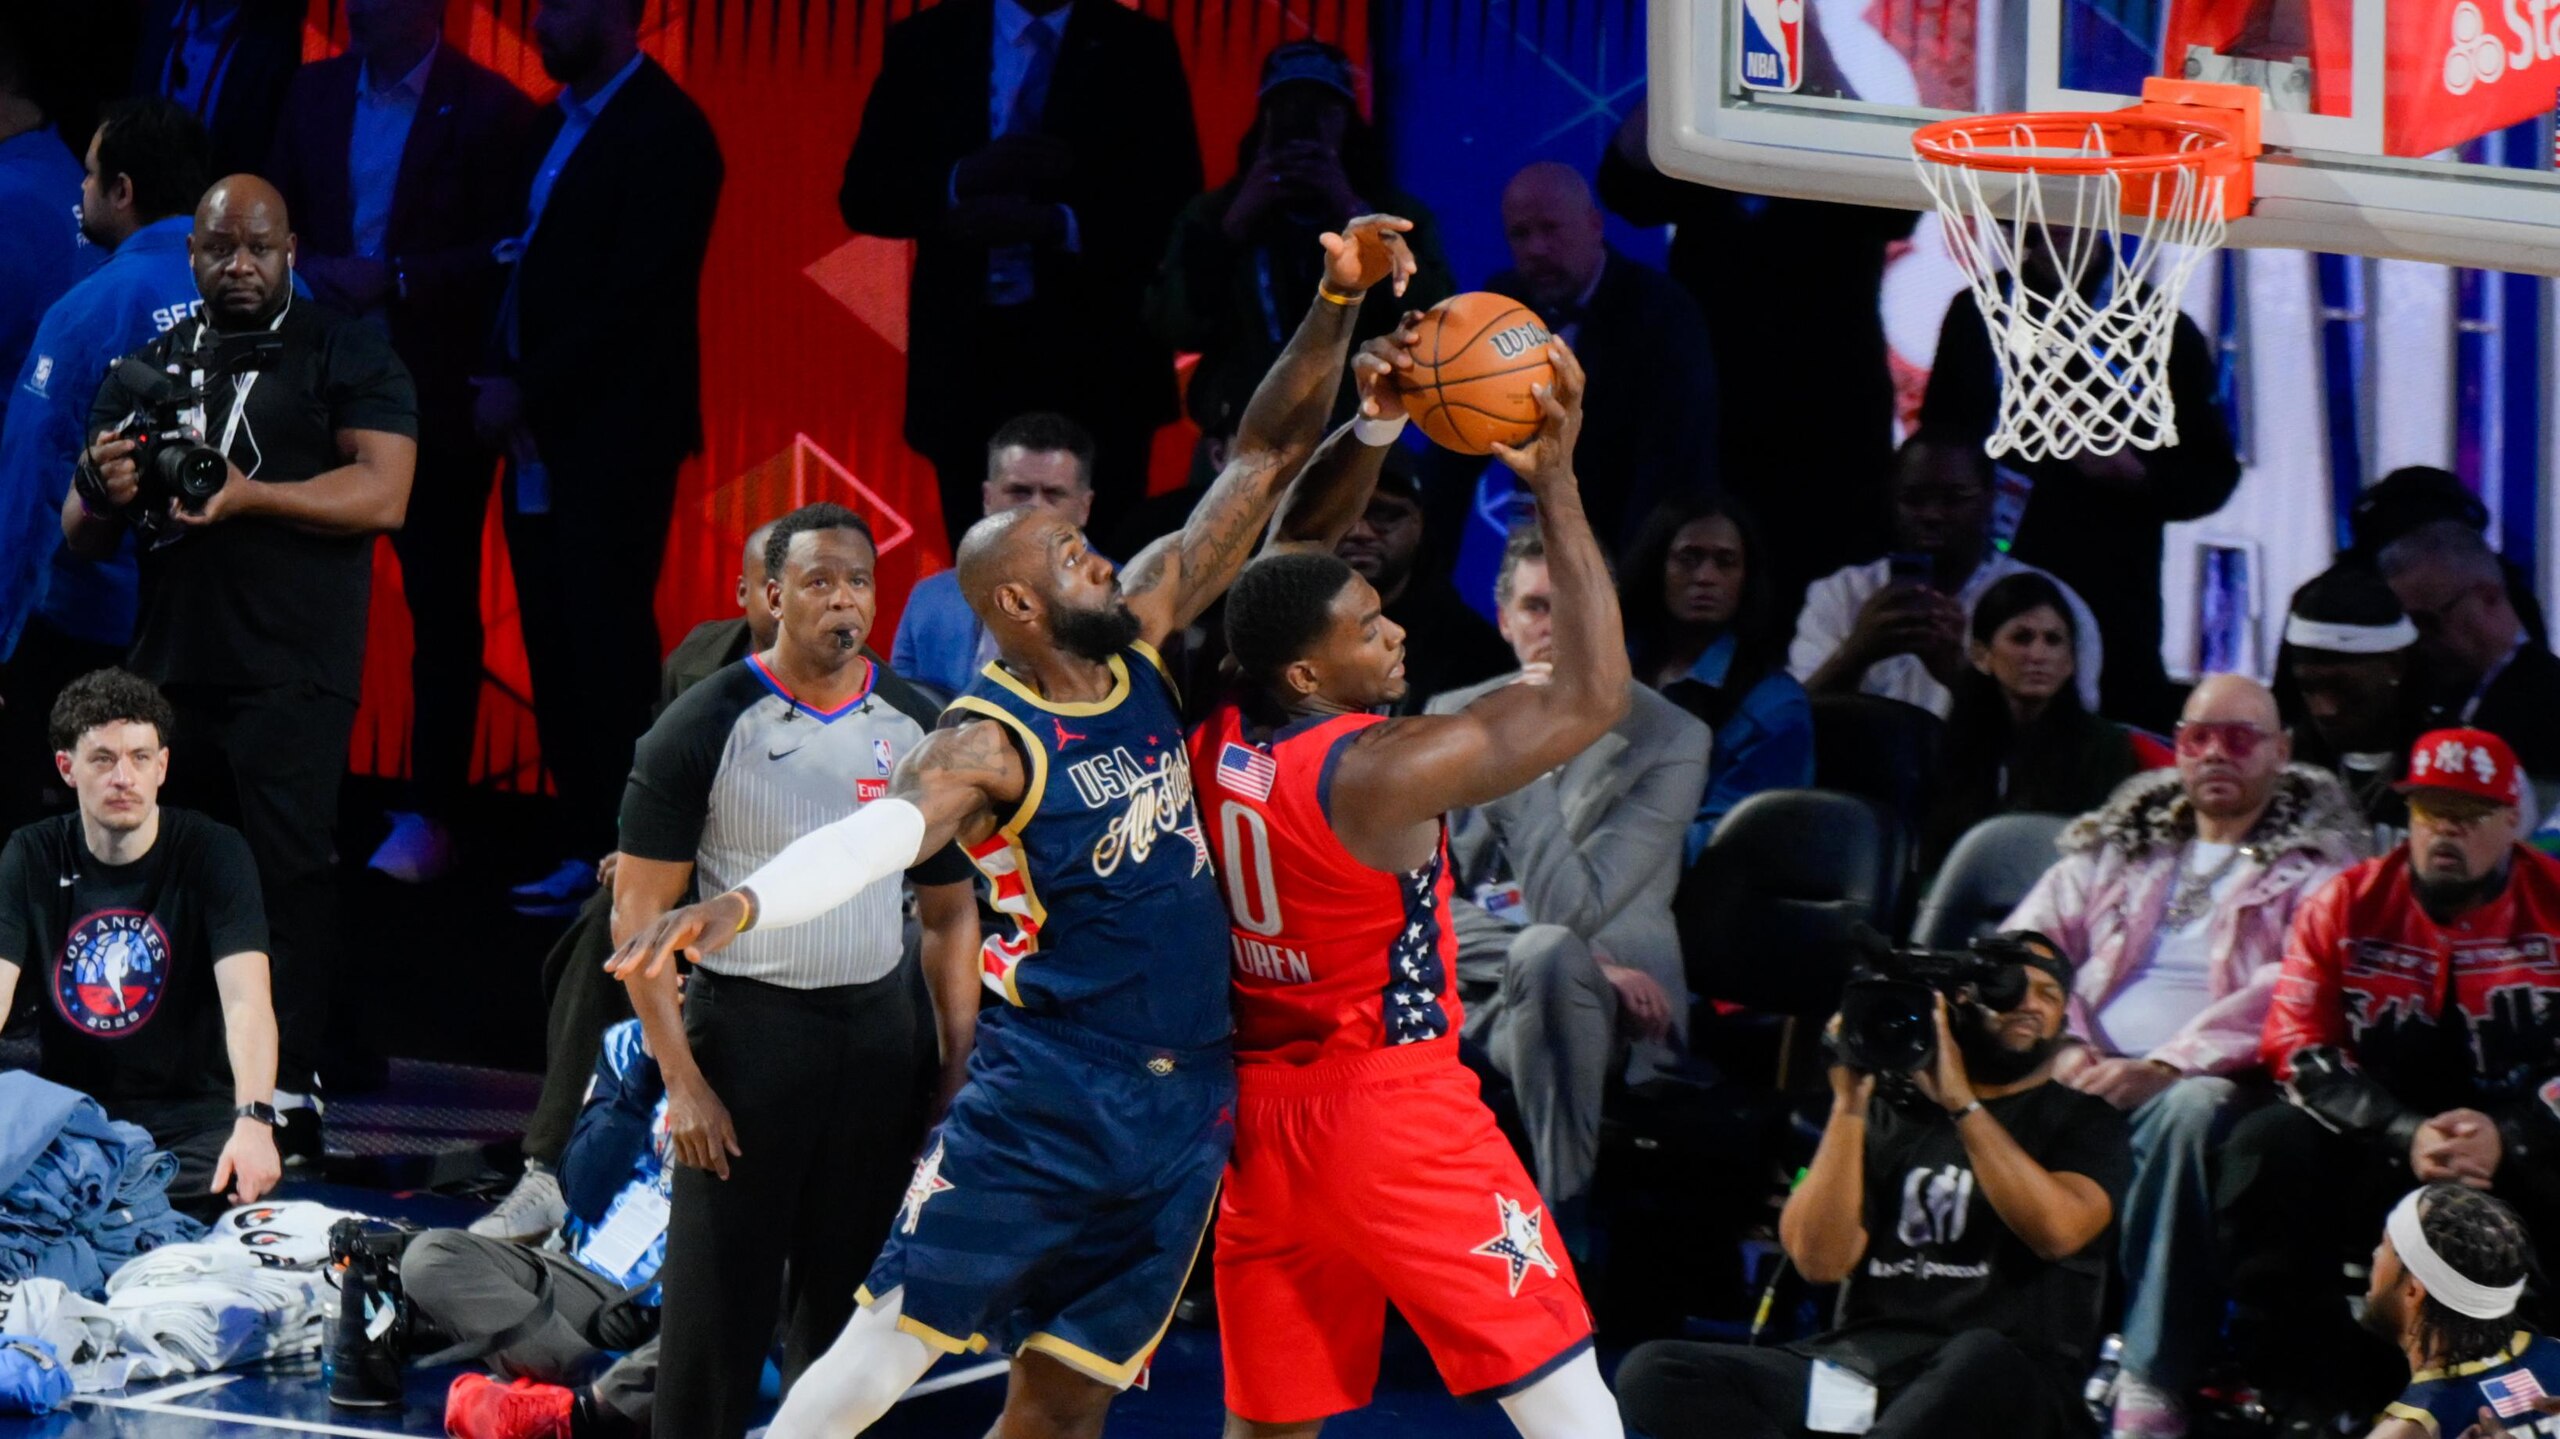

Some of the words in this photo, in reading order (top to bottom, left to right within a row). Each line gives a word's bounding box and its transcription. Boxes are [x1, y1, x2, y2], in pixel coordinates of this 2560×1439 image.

[1746, 52, 1778, 79] NBA
[857, 783, 886, 798] Emi
[1067, 746, 1152, 808] USA
[1220, 799, 1283, 937] 0
[62, 931, 87, 972] LOS
[96, 916, 165, 961] ANGLES
[1231, 933, 1312, 983] UREN
